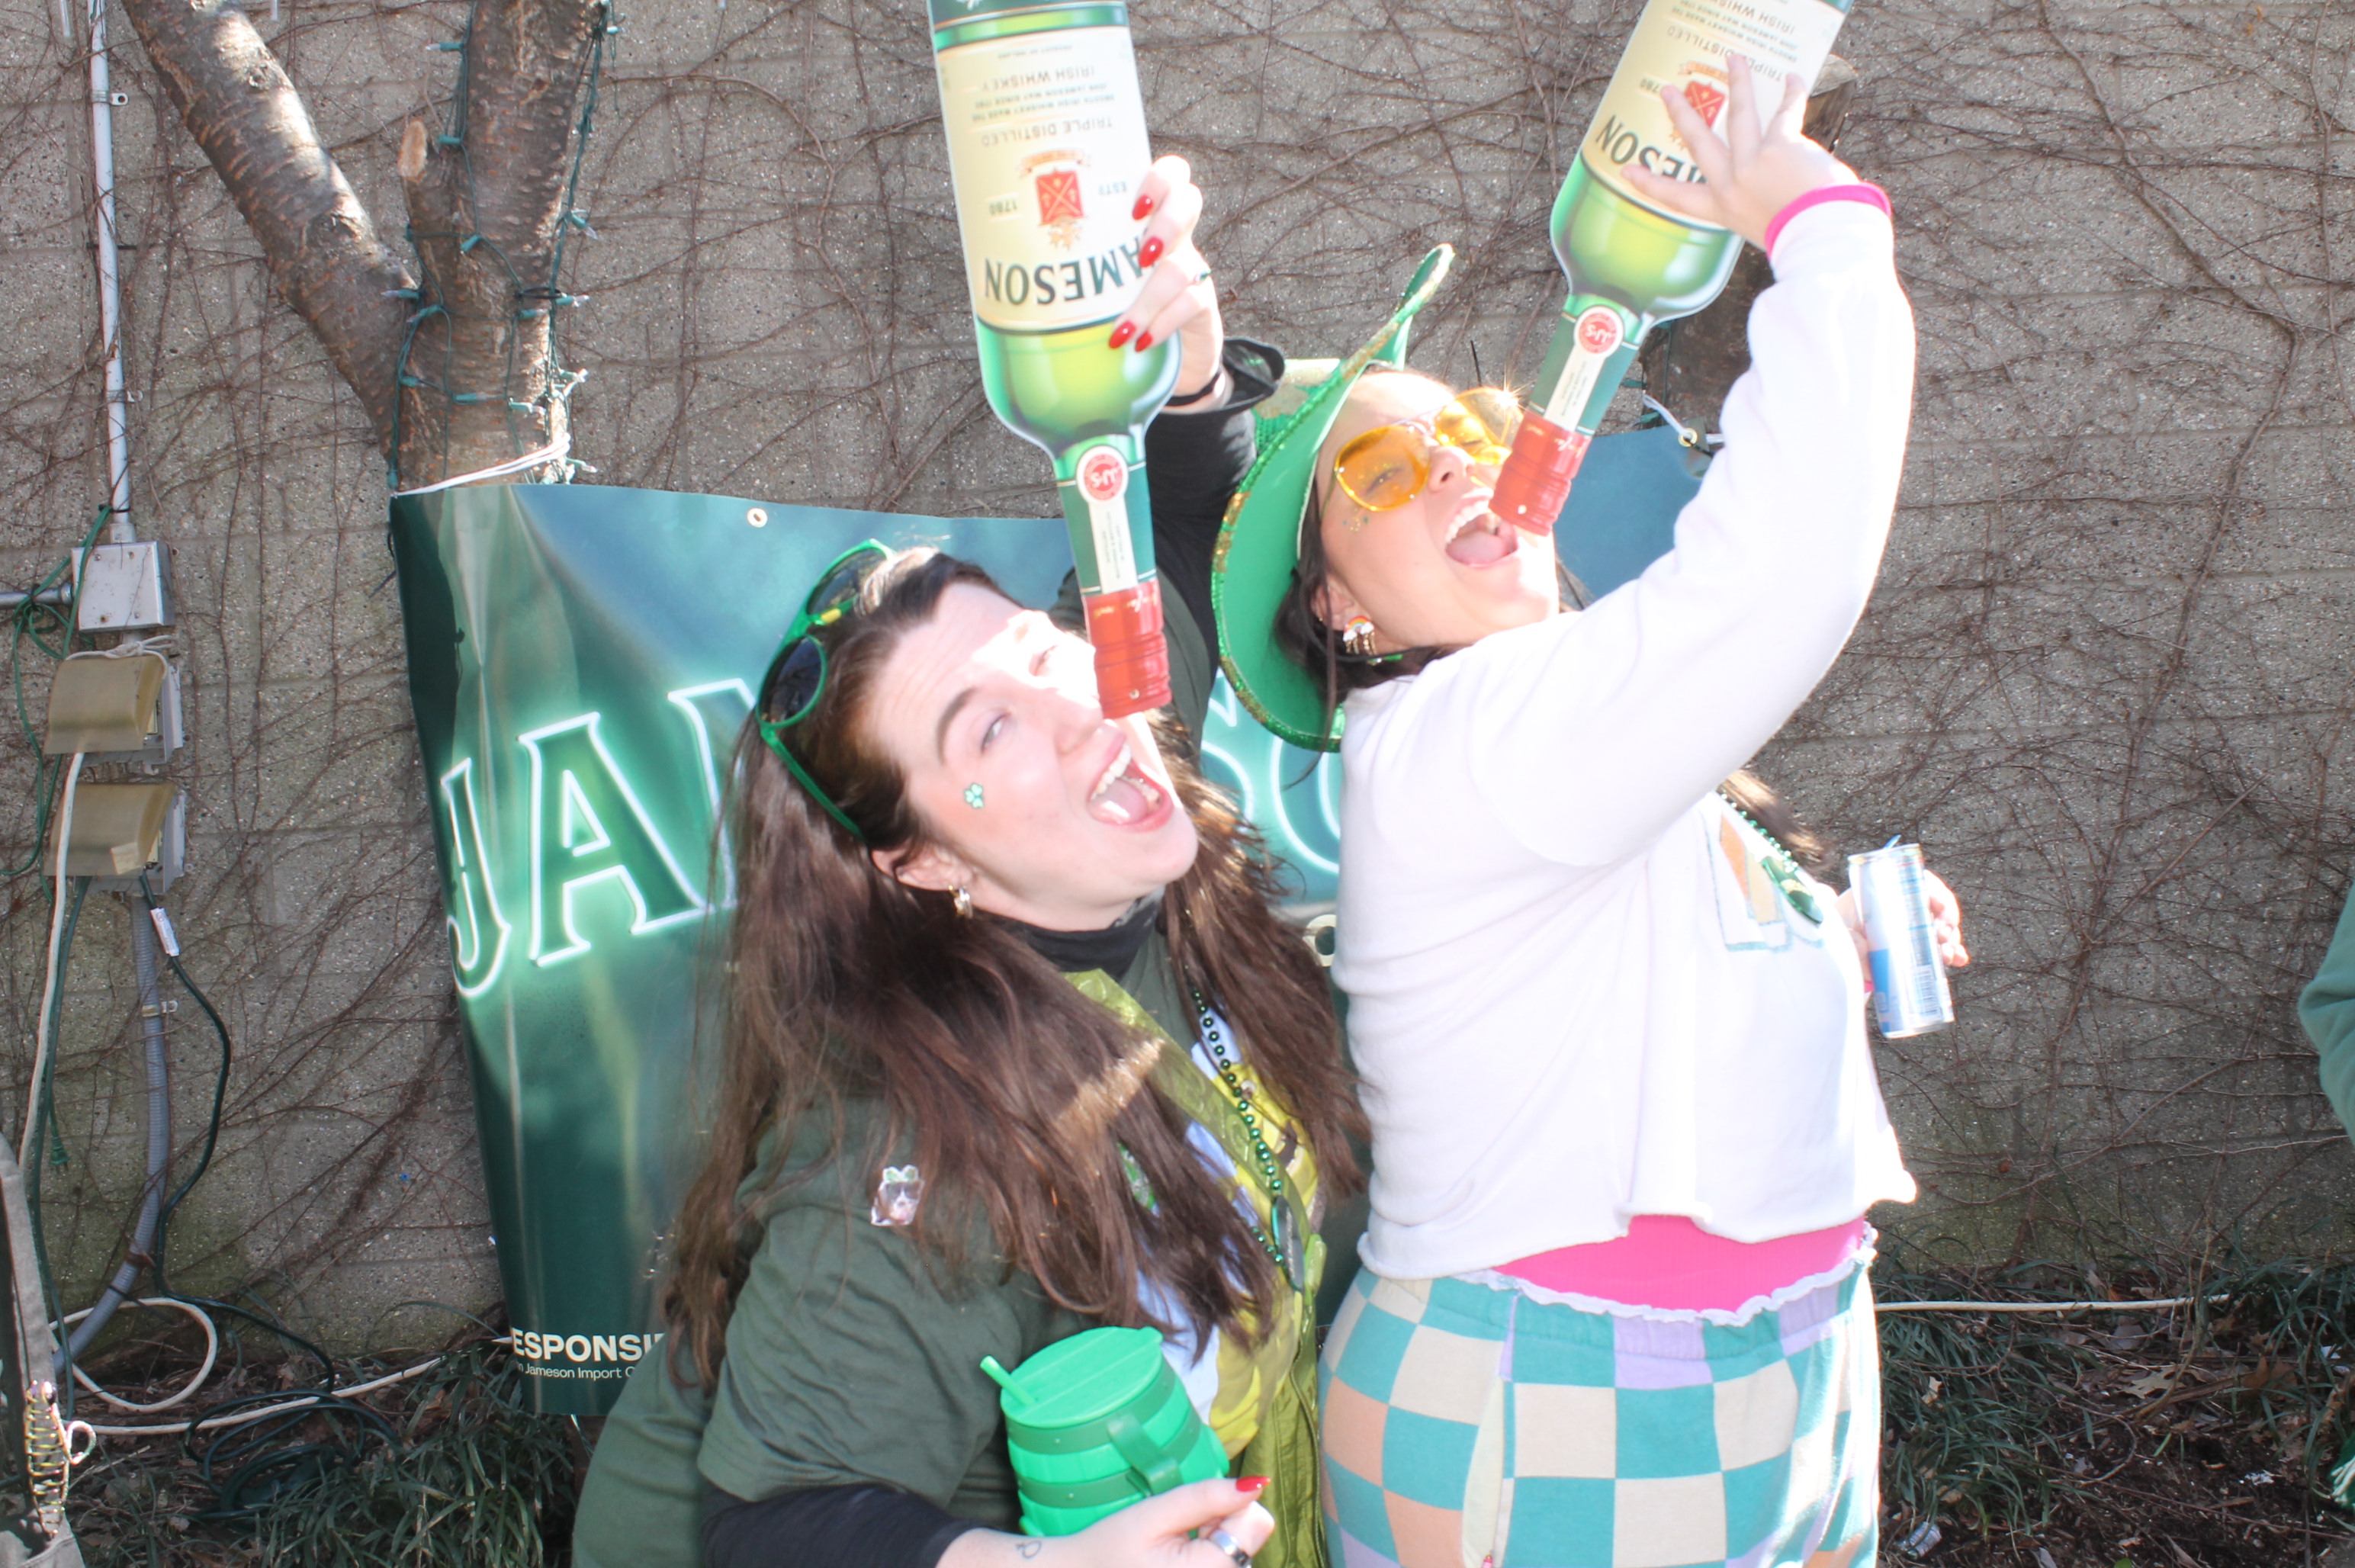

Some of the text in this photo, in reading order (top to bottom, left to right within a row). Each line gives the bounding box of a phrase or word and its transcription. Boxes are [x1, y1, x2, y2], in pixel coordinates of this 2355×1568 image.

[1714, 0, 1796, 34] IRISH WHIS
[982, 65, 1095, 92] IRISH WHISKEY
[1746, 56, 1783, 82] TRIPL
[1639, 78, 1660, 93] 780
[981, 116, 1113, 146] TRIPLE DISTILLED
[1595, 114, 1708, 184] ESON
[985, 236, 1145, 306] AMESON
[512, 1327, 665, 1363] ESPONSI
[525, 1365, 575, 1379] Jameson
[577, 1367, 622, 1381] Import
